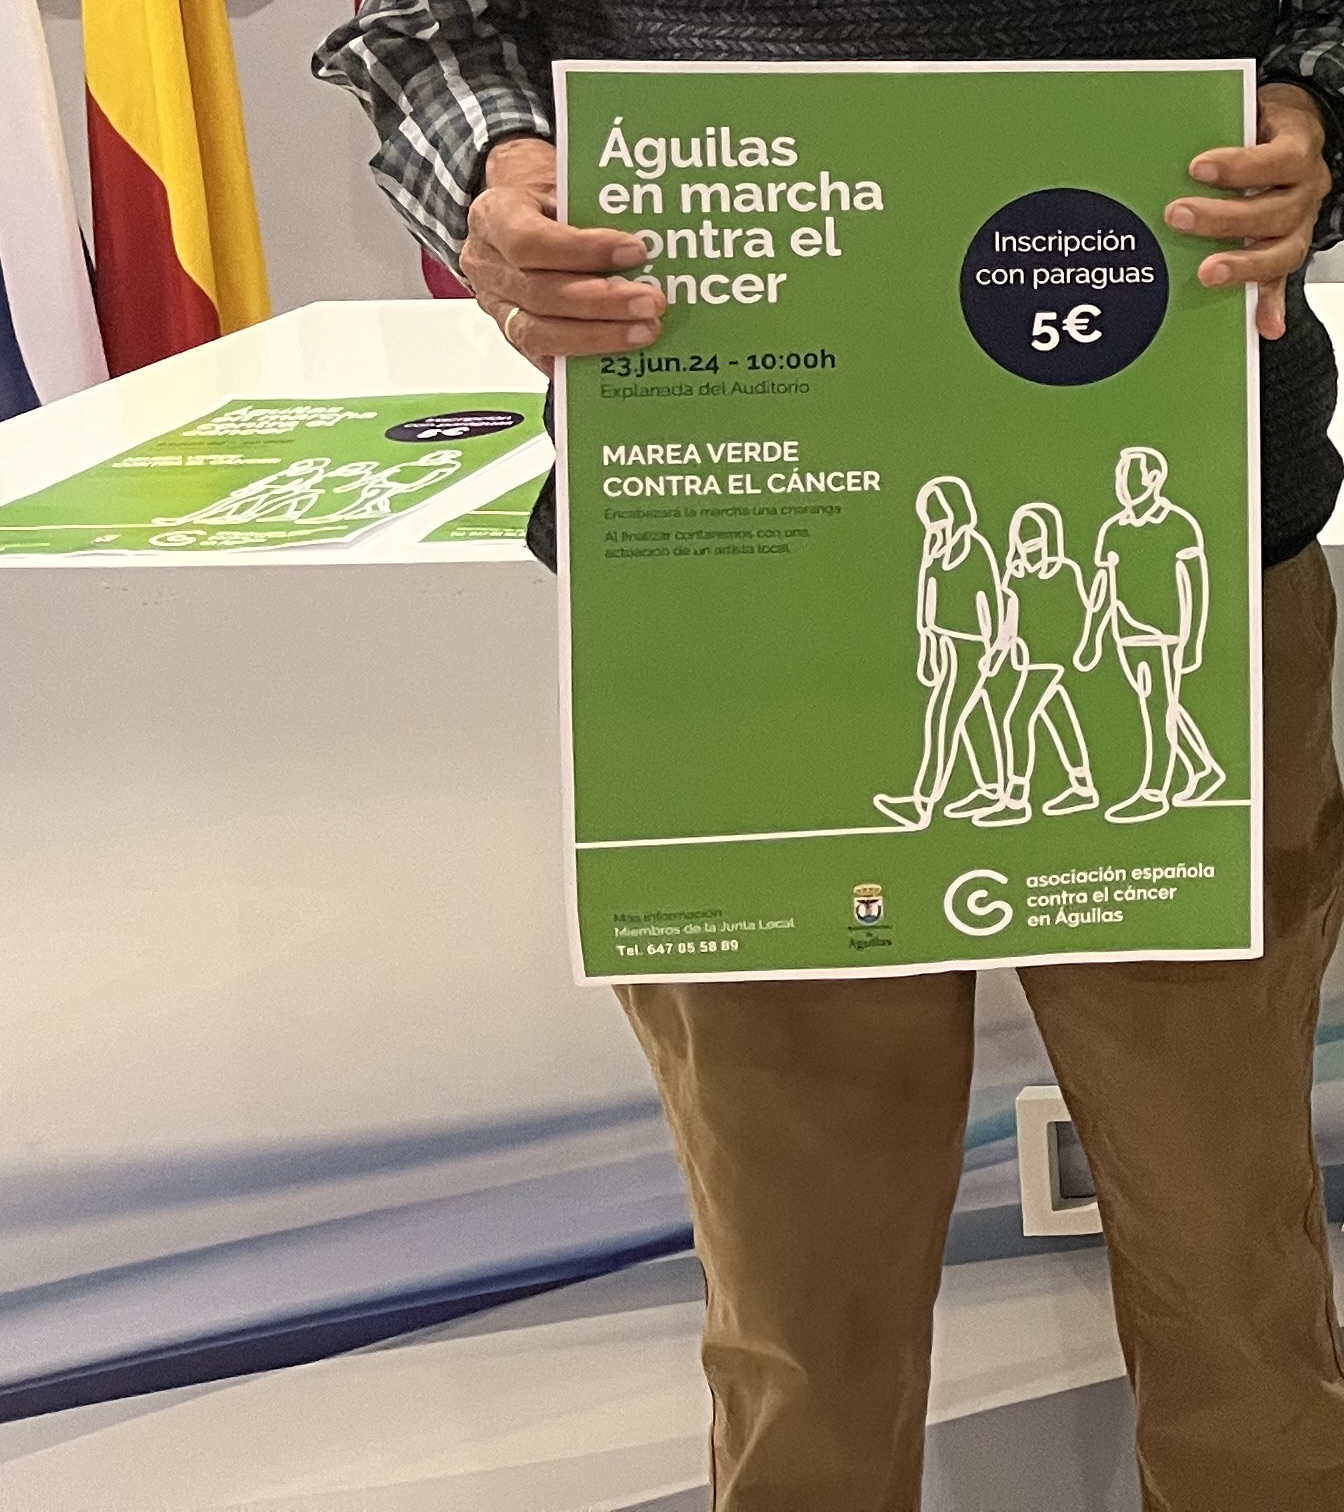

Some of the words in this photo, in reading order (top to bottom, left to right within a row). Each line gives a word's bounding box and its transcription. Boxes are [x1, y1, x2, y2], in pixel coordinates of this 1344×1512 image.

[599, 116, 798, 179] Águilas
[599, 183, 663, 214] en
[681, 171, 884, 213] marcha
[633, 219, 775, 259] ontra
[790, 216, 842, 257] el
[995, 229, 1136, 257] Inscripción
[975, 268, 1024, 285] con
[1033, 265, 1155, 290] paraguas
[1031, 303, 1103, 352] 5€
[600, 352, 720, 378] 23.jun.24
[747, 349, 836, 371] 10:00h
[601, 383, 694, 400] Explanada
[698, 381, 727, 396] del
[727, 380, 810, 395] Auditorio
[603, 443, 701, 466] MAREA
[707, 441, 800, 463] VERDE
[603, 475, 722, 497] CONTRA
[728, 474, 761, 495] EL
[767, 468, 881, 493] CÁNCER
[1026, 866, 1127, 888] asociación
[1131, 862, 1215, 883] española
[1026, 890, 1088, 907] contra
[1092, 887, 1109, 903] el
[1113, 885, 1178, 902] cáncer
[758, 918, 795, 930] Local
[1027, 913, 1051, 927] en
[1054, 906, 1124, 928] Águilas
[647, 942, 673, 955] 647
